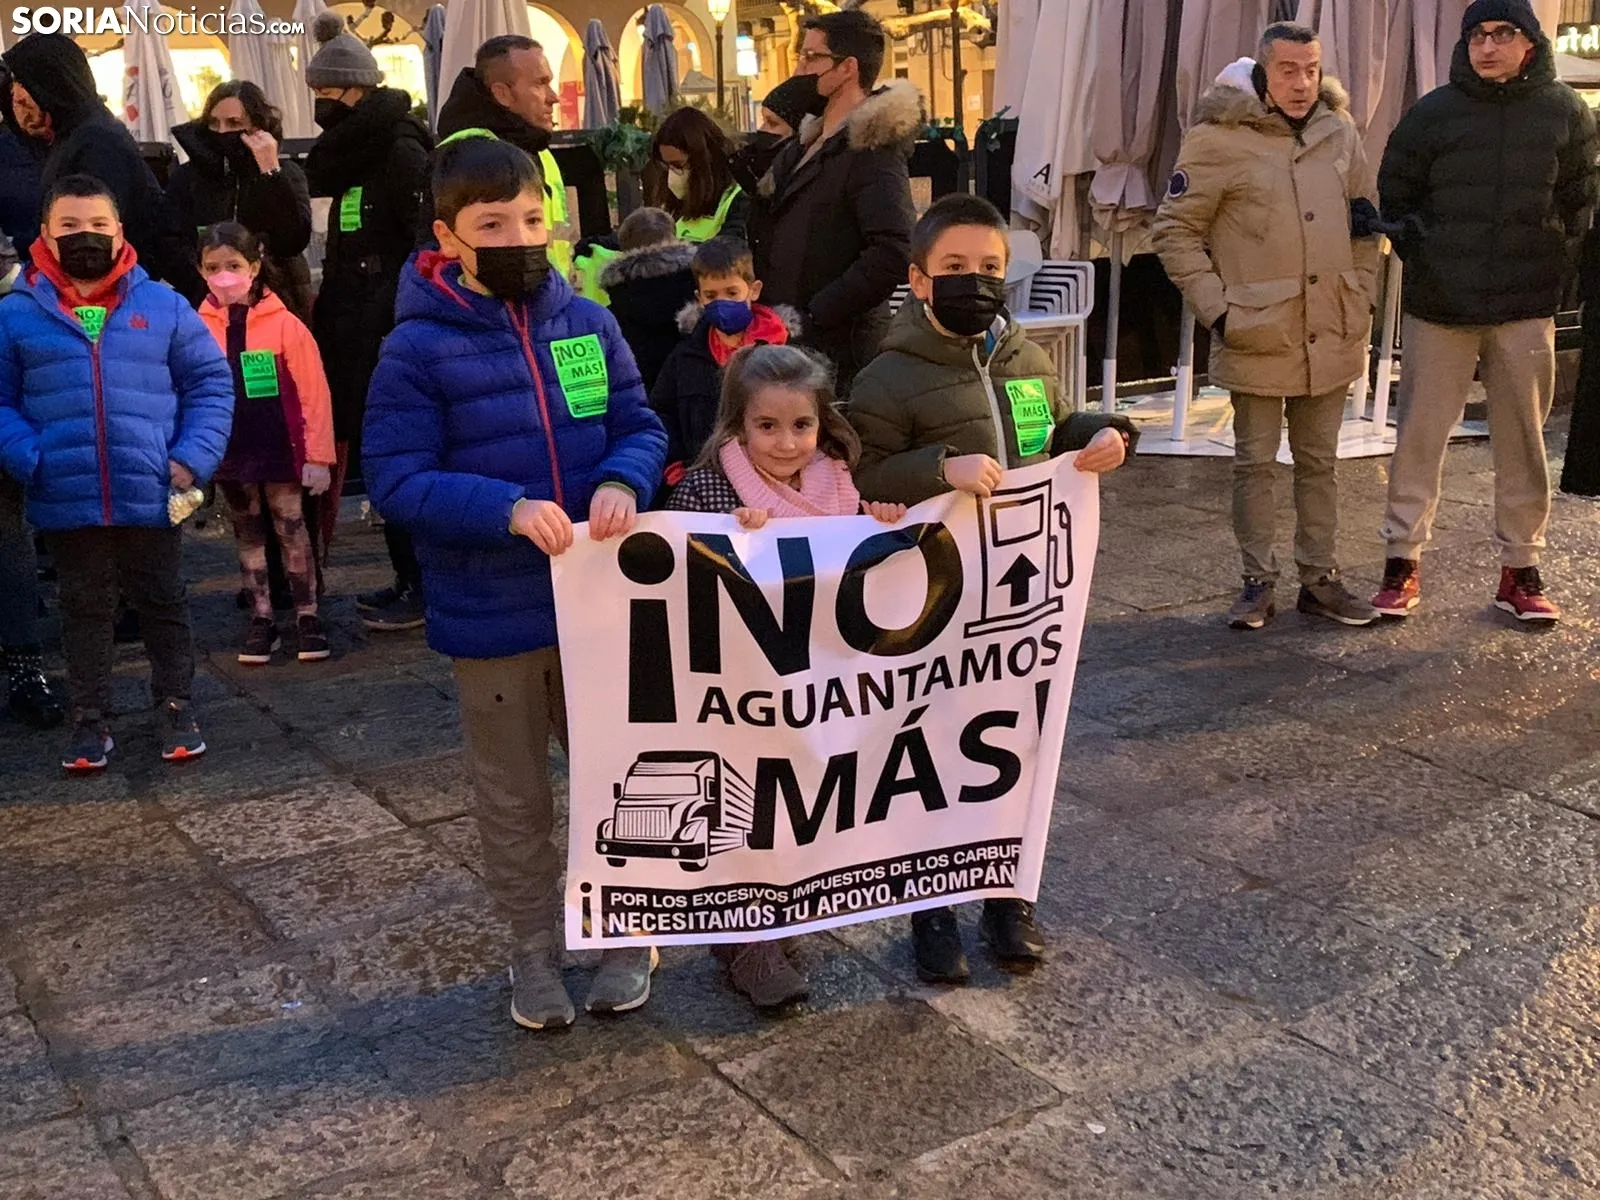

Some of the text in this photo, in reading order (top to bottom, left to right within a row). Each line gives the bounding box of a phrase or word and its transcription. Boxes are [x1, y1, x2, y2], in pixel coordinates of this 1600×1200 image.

[553, 342, 587, 367] ¡NO
[571, 360, 605, 379] MÁS!
[617, 520, 965, 724] ¡NO
[697, 624, 1063, 728] AGUANTAMOS
[610, 892, 648, 907] POR
[652, 894, 688, 908] LOS
[692, 887, 789, 907] EXCESIVOS
[792, 866, 886, 900] IMPUESTOS
[890, 861, 913, 877] DE
[916, 853, 950, 872] LOS
[608, 904, 776, 934] NECESITAMOS
[782, 899, 809, 923] TU
[816, 883, 898, 917] APOYO,
